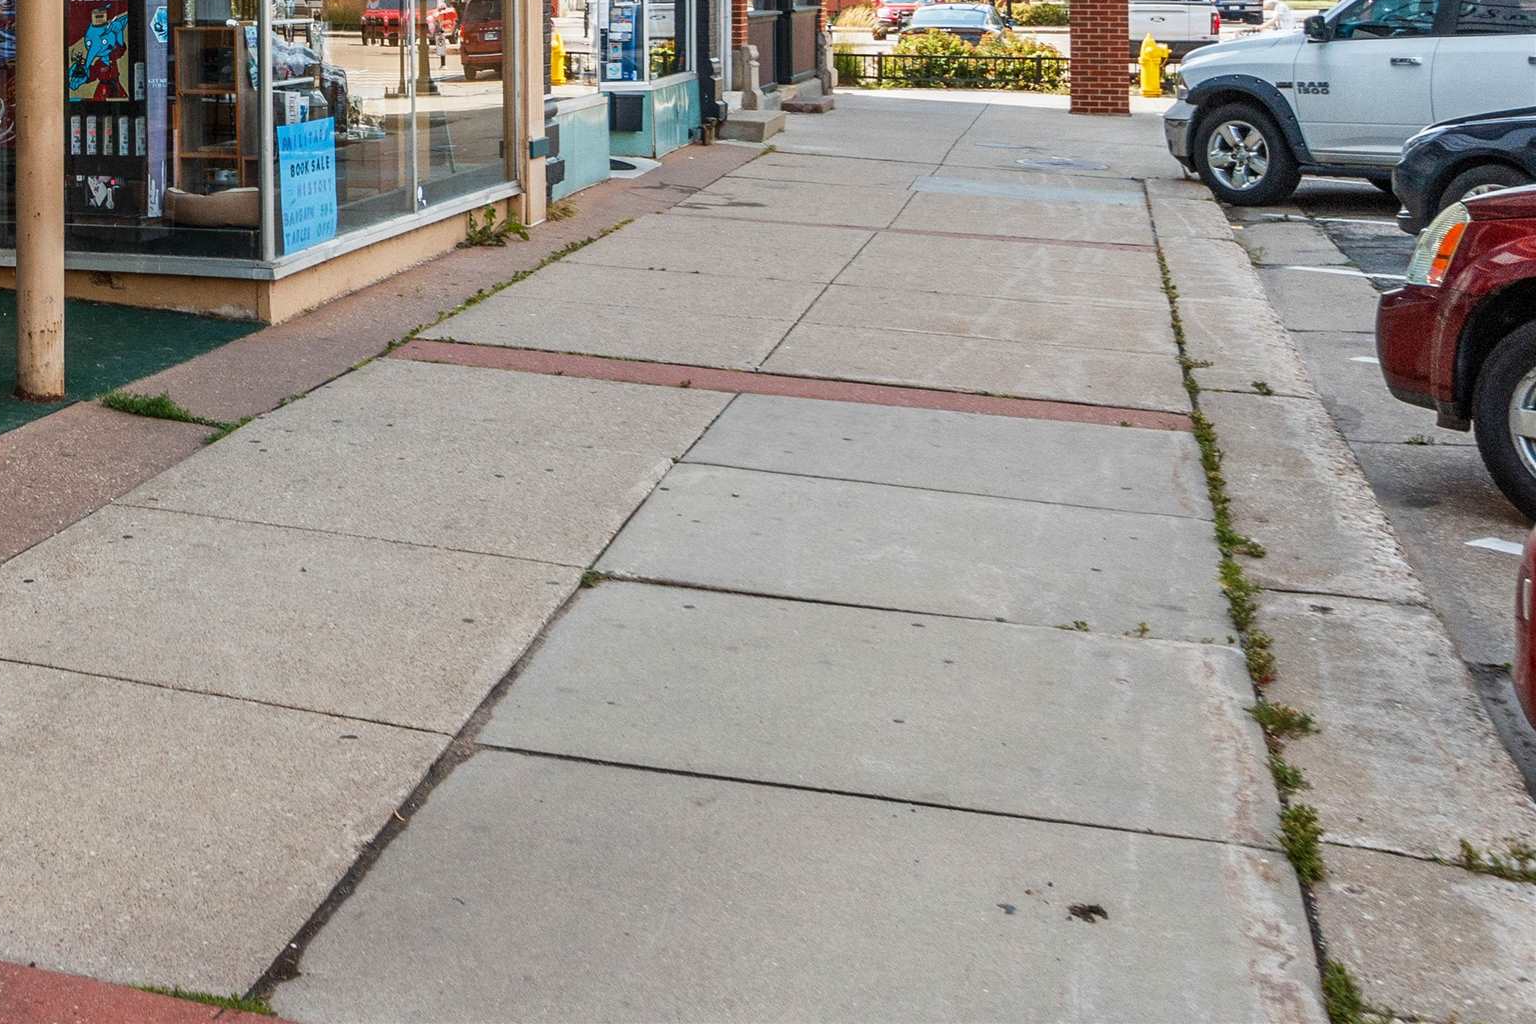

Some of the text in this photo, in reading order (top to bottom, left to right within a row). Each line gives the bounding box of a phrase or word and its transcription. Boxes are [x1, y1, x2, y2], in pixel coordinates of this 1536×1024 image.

[1298, 87, 1330, 95] 1500
[290, 155, 331, 178] BOOK SALE
